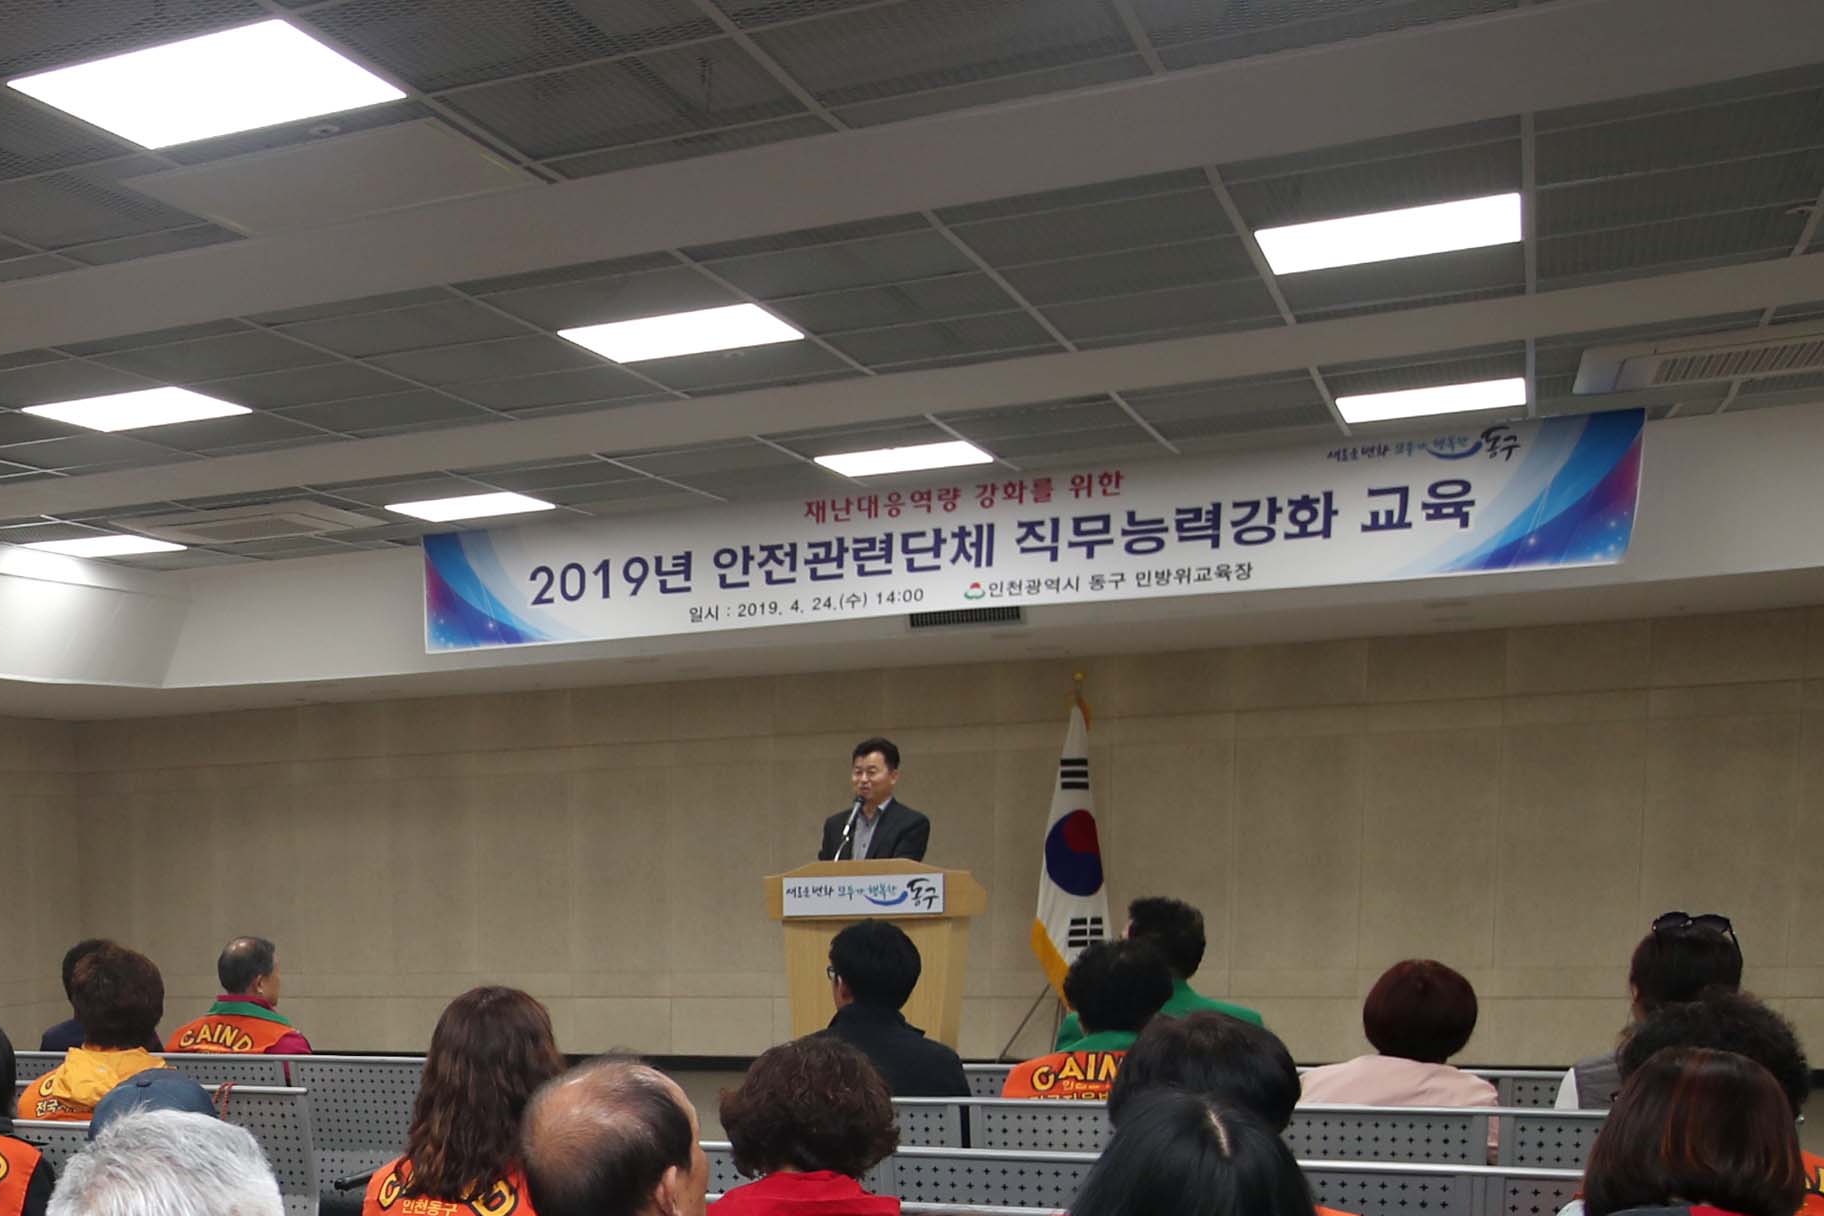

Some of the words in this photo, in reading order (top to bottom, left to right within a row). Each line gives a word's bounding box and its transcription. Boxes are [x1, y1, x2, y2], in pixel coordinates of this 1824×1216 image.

[804, 486, 961, 524] 재난대응역량
[975, 477, 1054, 509] 강화를
[1069, 470, 1124, 499] 위한
[529, 550, 693, 605] 2019년
[713, 522, 995, 590] 안전관련단체
[1015, 489, 1338, 562] 직무능력강화
[1360, 477, 1477, 535] 교육
[988, 575, 1080, 598] 인천광역시
[1088, 572, 1126, 591] 동구
[1136, 562, 1254, 588] 민방위교육장
[689, 605, 719, 623] 일시
[737, 600, 782, 618] 2019.
[790, 599, 804, 614] 4.
[877, 589, 924, 604] 14:00
[907, 878, 939, 910] 동구
[1032, 1053, 1123, 1091] CAIN
